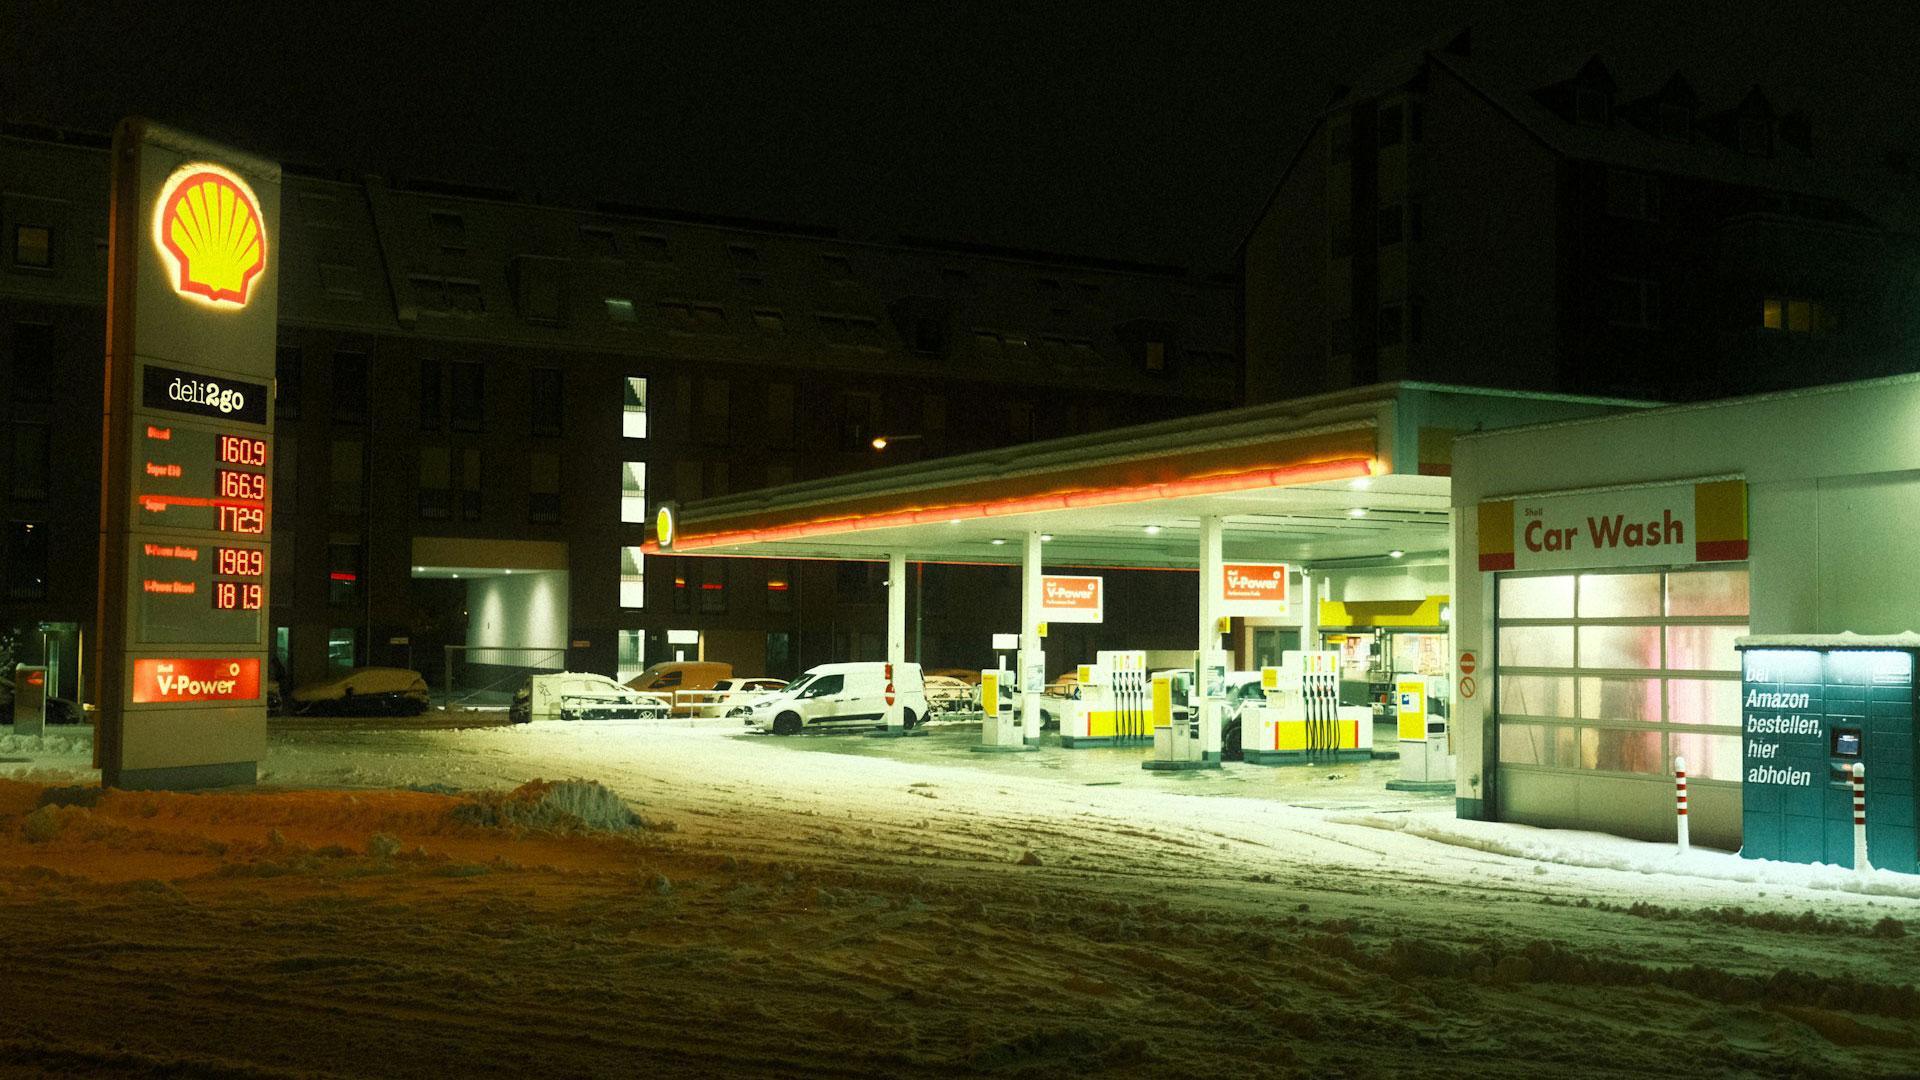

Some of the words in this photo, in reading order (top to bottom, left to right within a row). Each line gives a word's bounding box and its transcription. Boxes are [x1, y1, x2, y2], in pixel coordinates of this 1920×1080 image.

[169, 378, 245, 413] deli2go
[221, 437, 265, 466] 160.9
[221, 471, 265, 500] 166.9
[220, 505, 264, 533] 172.9
[1524, 519, 1578, 553] Car
[1586, 509, 1684, 549] Wash
[219, 548, 263, 576] 198.9
[1046, 587, 1093, 599] V-Power
[1227, 576, 1279, 589] V-Power
[217, 583, 262, 610] 181.9
[156, 675, 236, 696] V-Power
[1745, 688, 1810, 709] Amazon
[1747, 714, 1823, 738] bestellen,
[1747, 739, 1779, 758] hier
[1748, 765, 1811, 786] abholen
